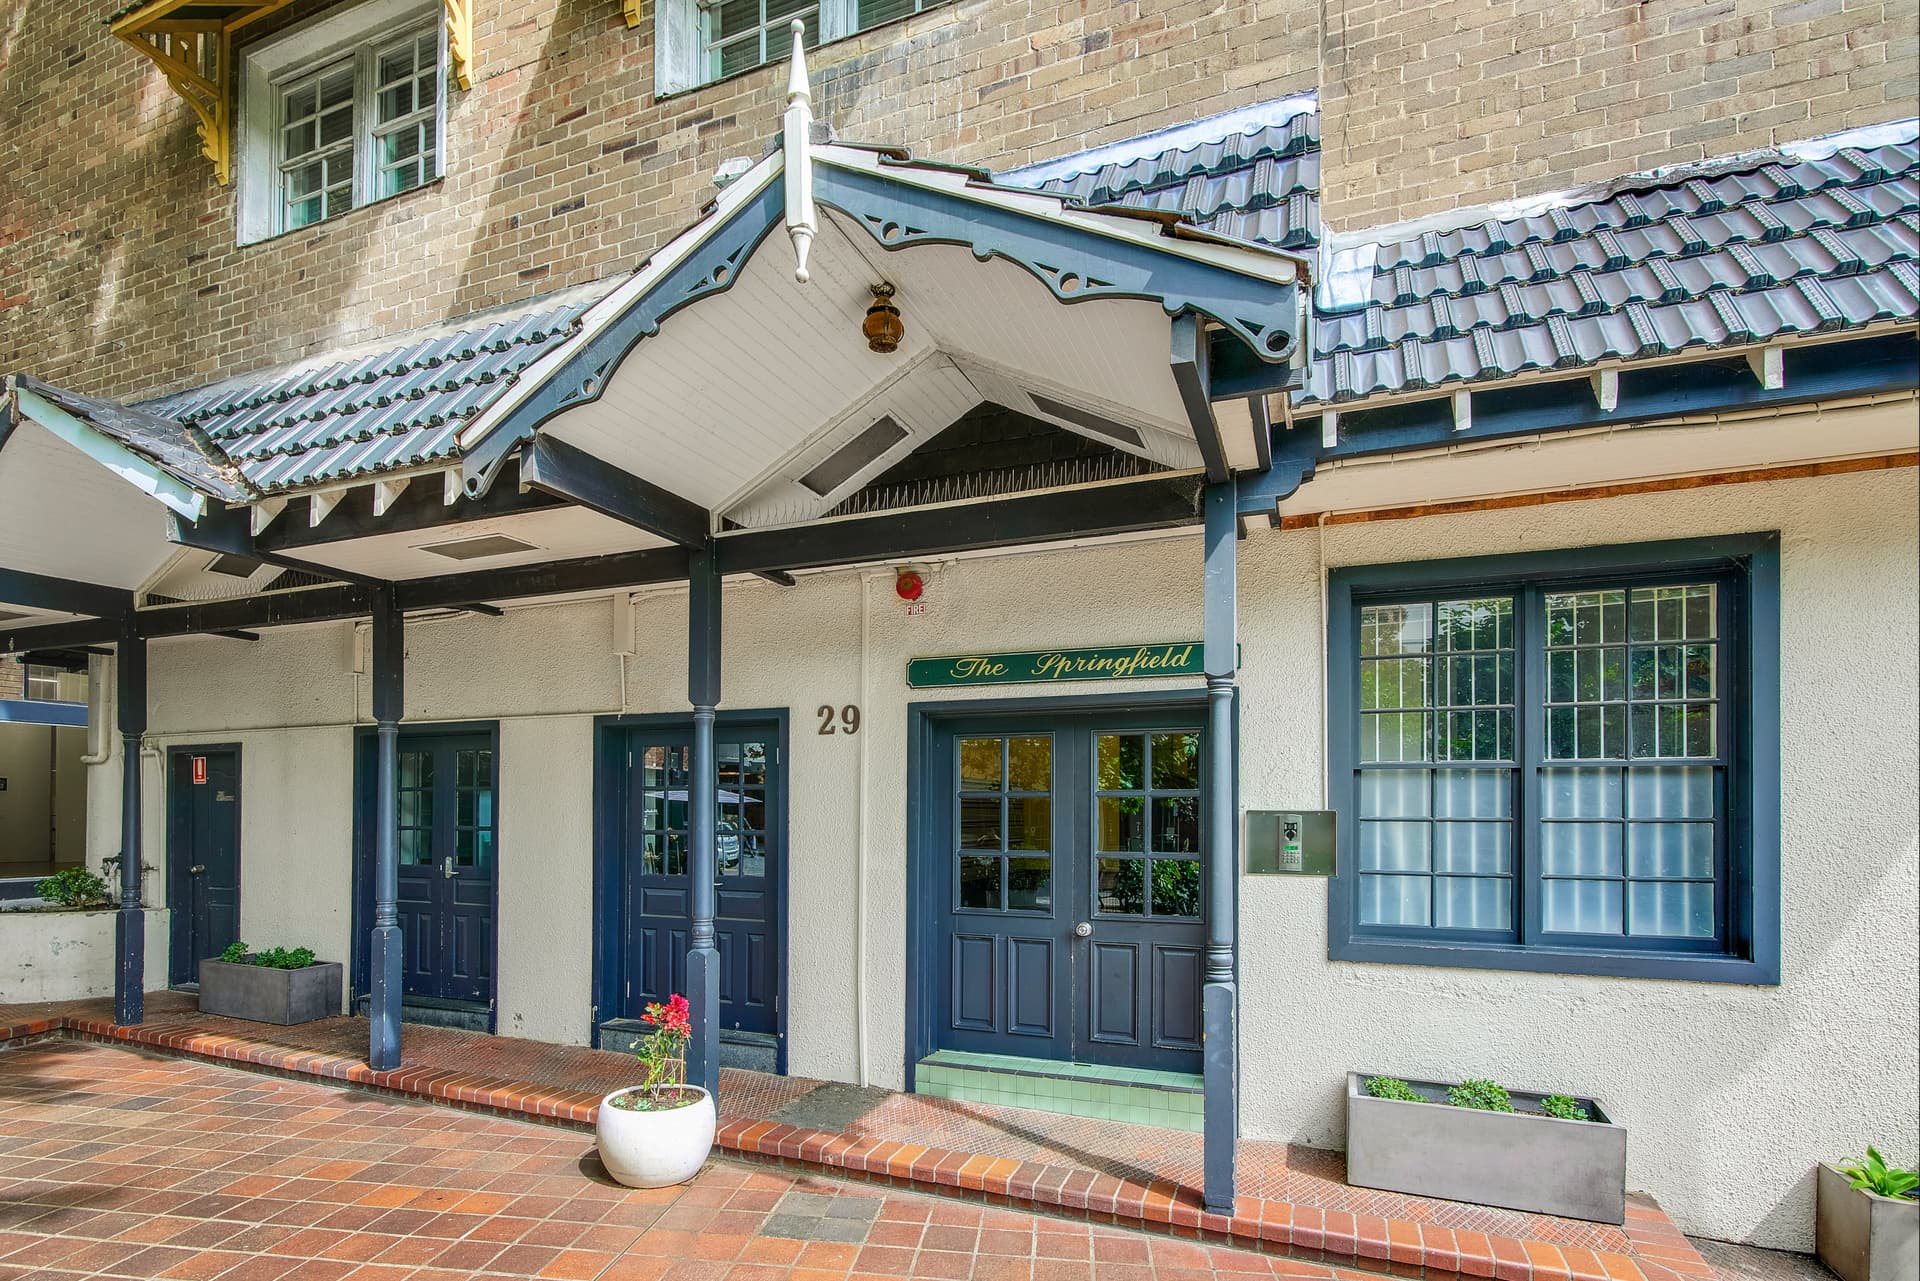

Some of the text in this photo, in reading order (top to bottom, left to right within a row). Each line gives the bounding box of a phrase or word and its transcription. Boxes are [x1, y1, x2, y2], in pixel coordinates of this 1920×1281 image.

[906, 604, 925, 615] FIRE
[950, 645, 1192, 678] The Springfield
[817, 705, 859, 735] 29
